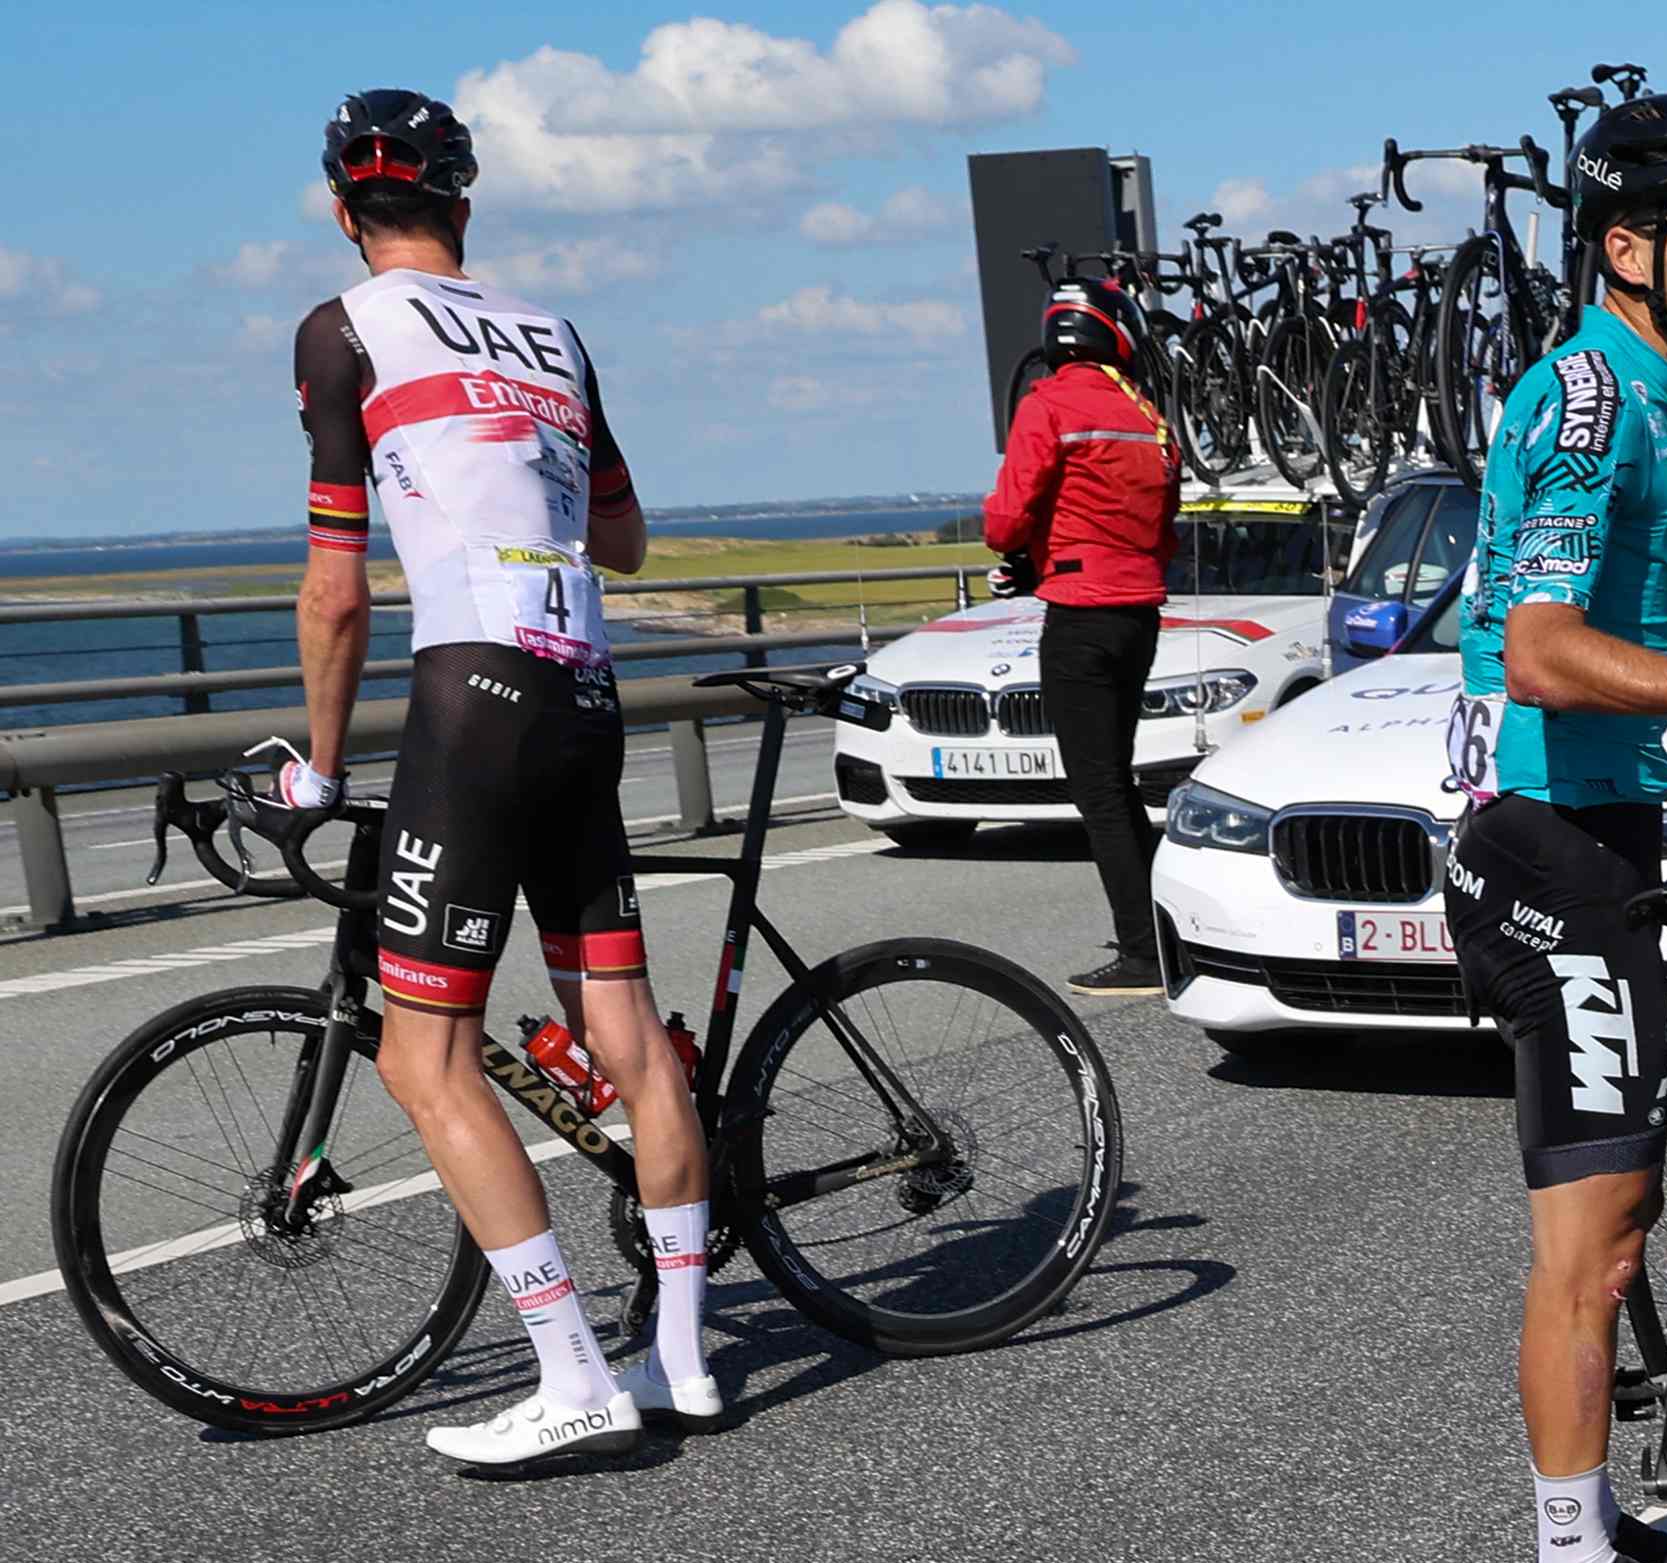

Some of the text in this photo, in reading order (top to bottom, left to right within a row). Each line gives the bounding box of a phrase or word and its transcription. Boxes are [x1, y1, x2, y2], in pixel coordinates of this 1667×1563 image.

[1576, 149, 1624, 191] bollé
[406, 297, 573, 381] UAE
[1558, 351, 1599, 449] SYNERGIE
[384, 451, 412, 494] FAB
[544, 567, 571, 634] 4
[945, 752, 1047, 775] 4141 LDM
[383, 829, 443, 937] UAE
[1499, 920, 1560, 953] concept
[1511, 900, 1567, 941] VITAL
[1341, 936, 1354, 953] B
[152, 1009, 327, 1063] PAGNOLO
[482, 1040, 610, 1155] LNAGO
[649, 1234, 681, 1256] AE
[503, 1260, 561, 1295] UAE
[160, 1364, 235, 1406] WTO
[355, 1334, 432, 1399] BORA
[536, 1407, 615, 1447] nimbl
